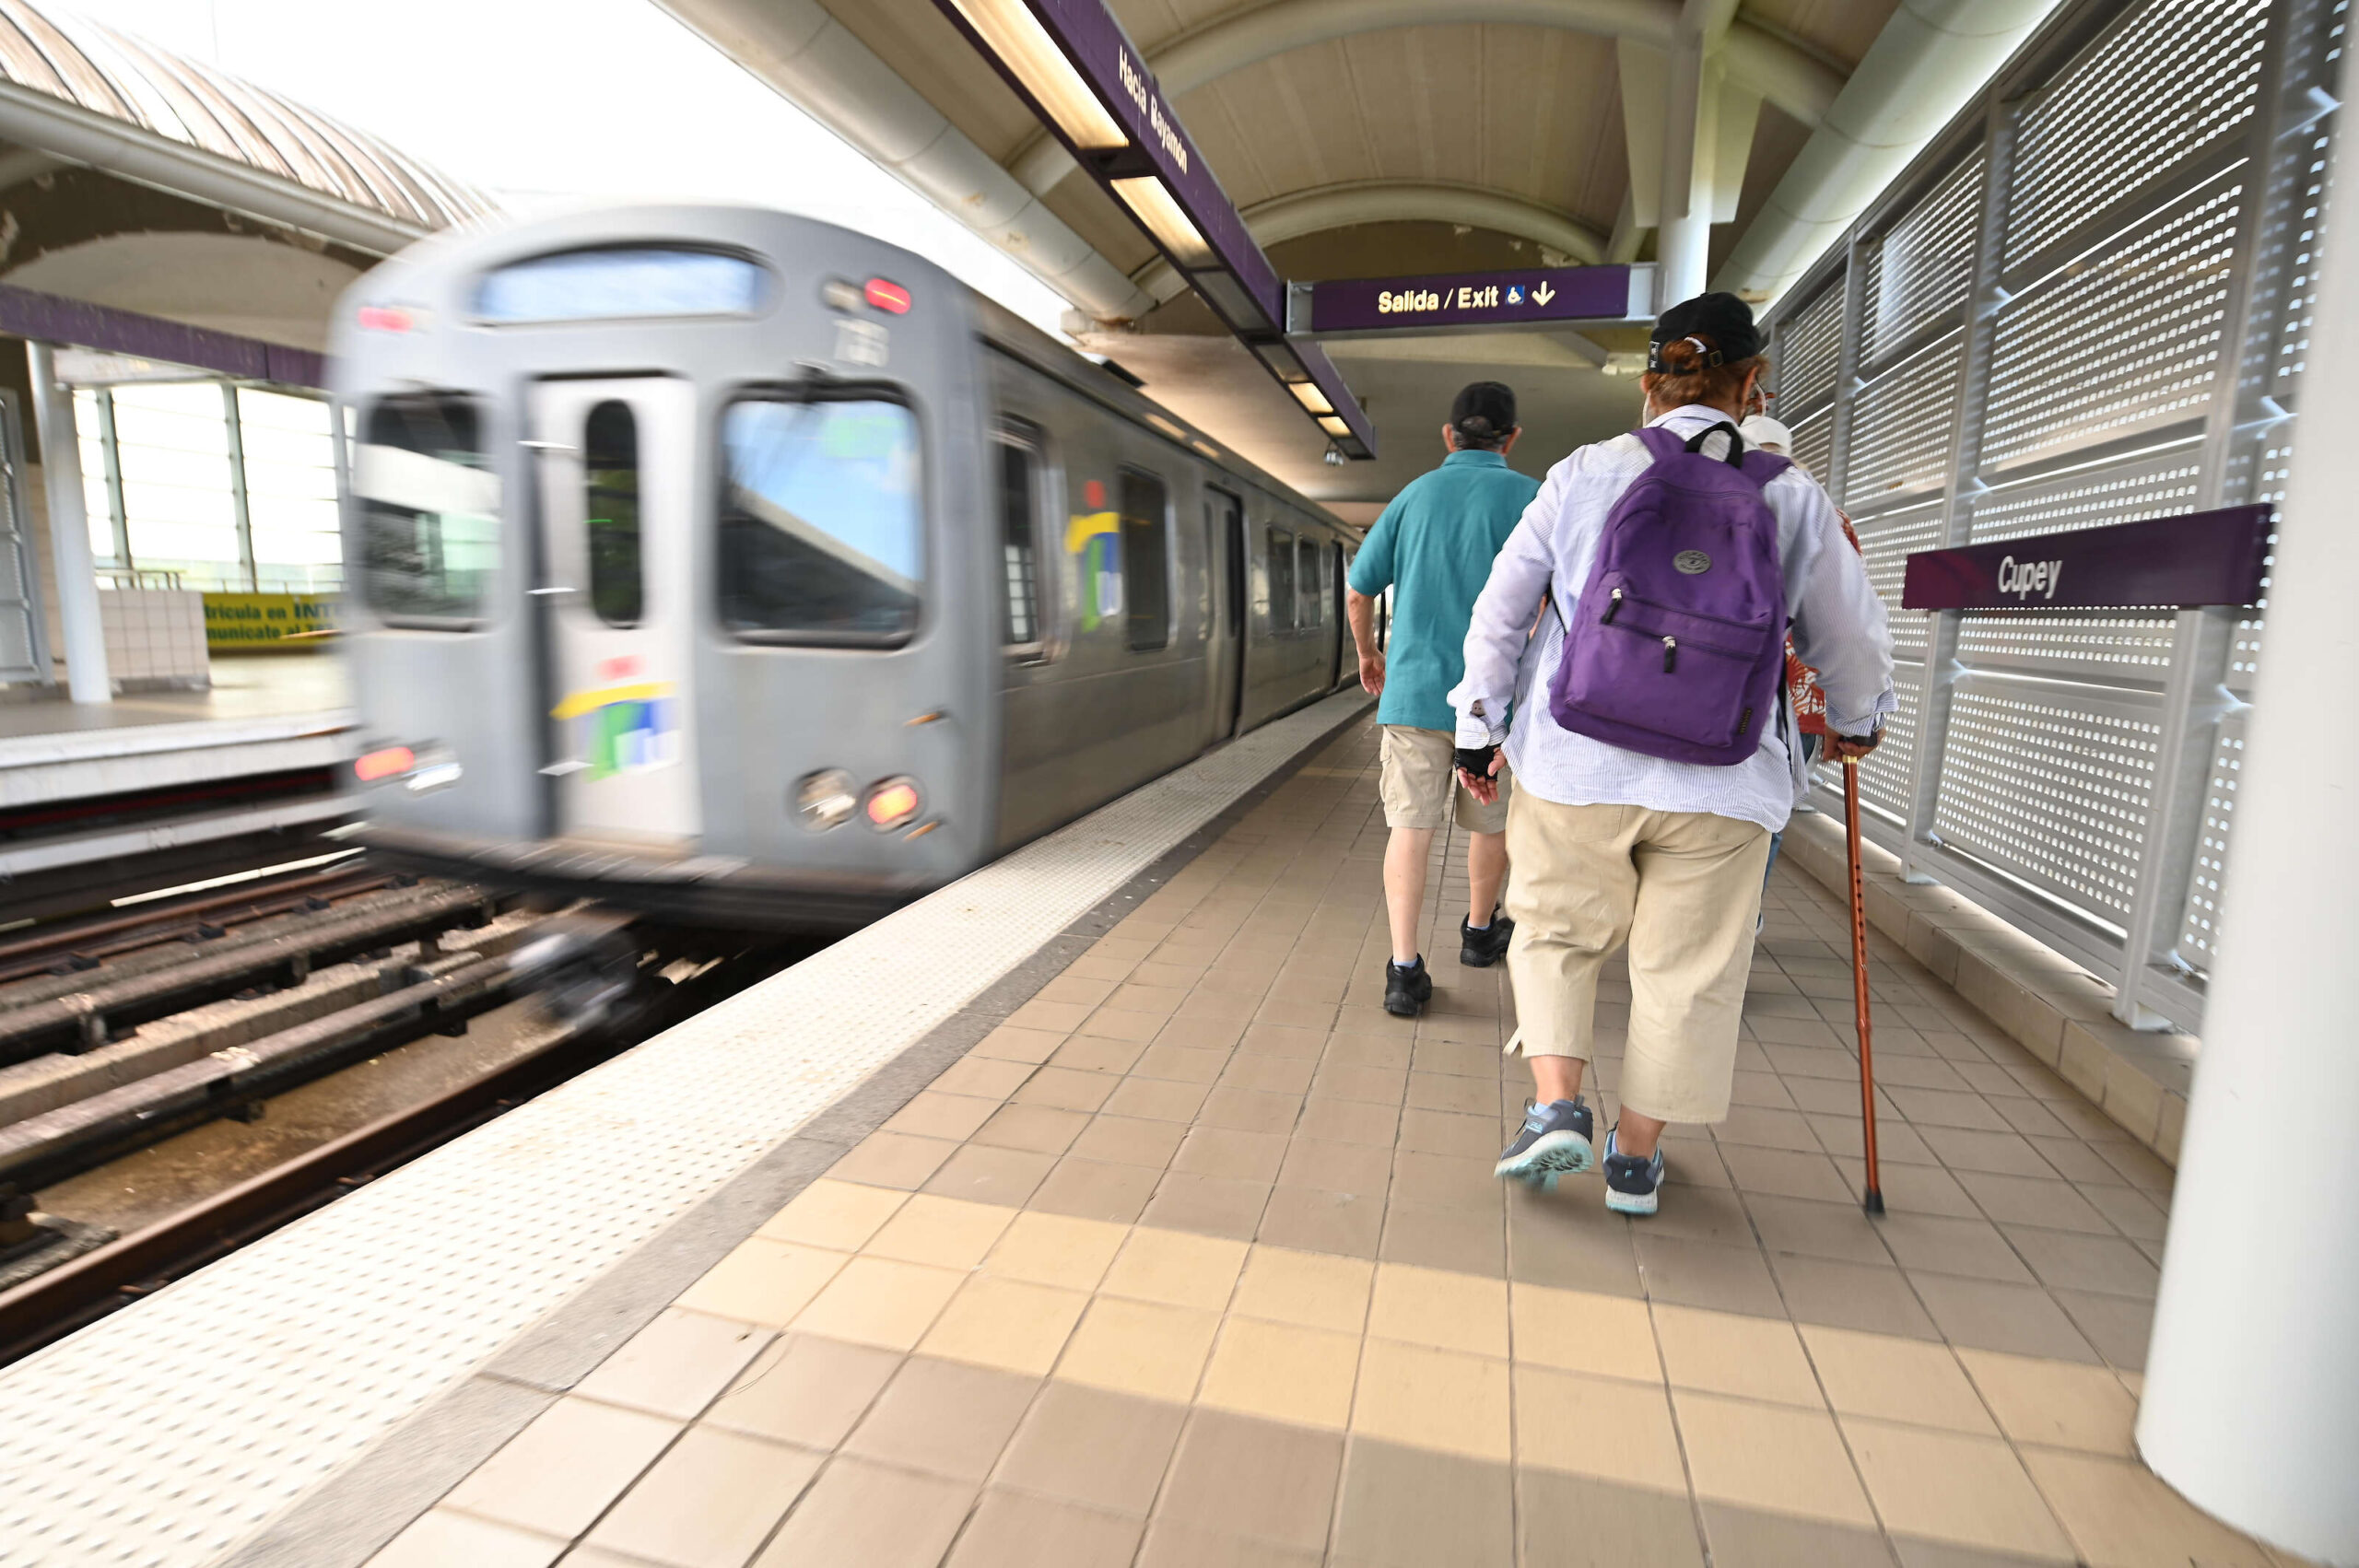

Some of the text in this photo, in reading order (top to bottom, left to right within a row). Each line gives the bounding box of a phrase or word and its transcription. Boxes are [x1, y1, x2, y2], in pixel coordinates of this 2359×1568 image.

[1119, 43, 1188, 176] Hacia Bayamón
[1378, 285, 1499, 314] Salida / Exit
[1997, 555, 2063, 601] Cupey
